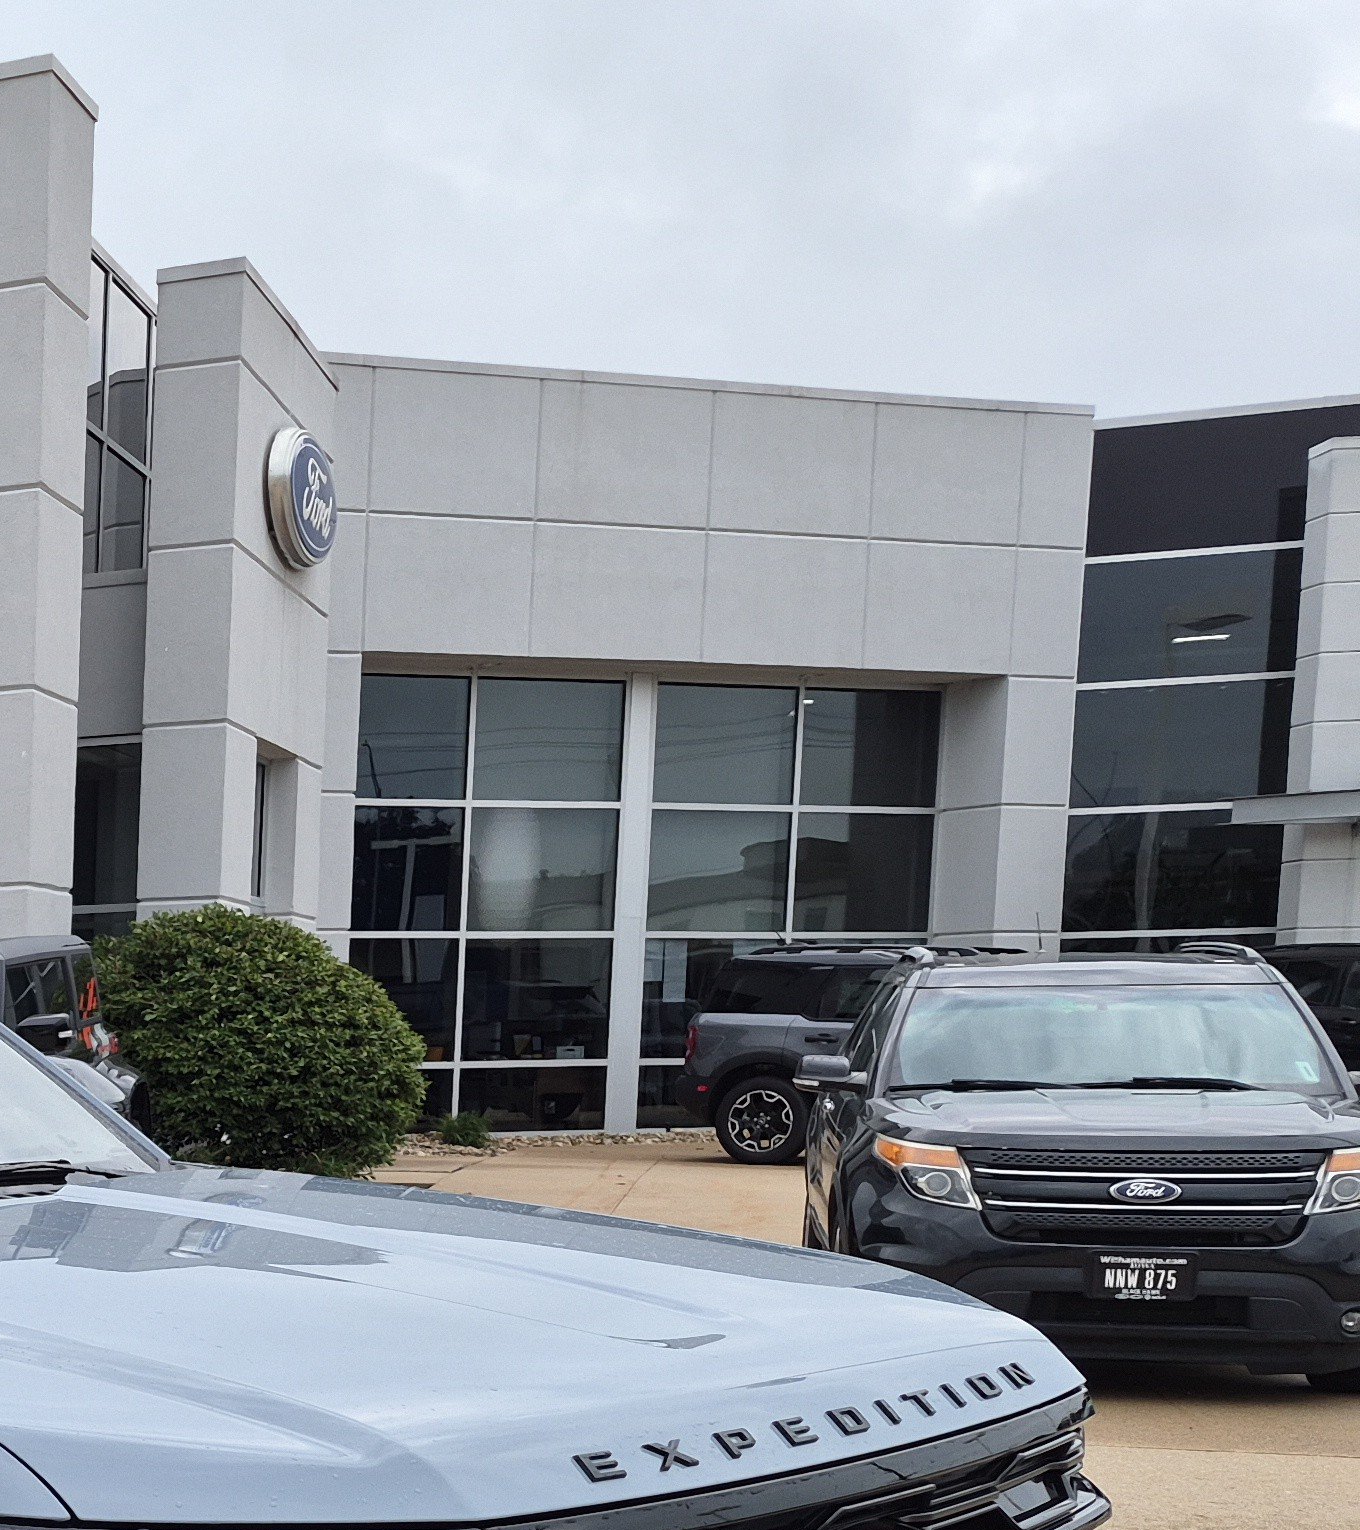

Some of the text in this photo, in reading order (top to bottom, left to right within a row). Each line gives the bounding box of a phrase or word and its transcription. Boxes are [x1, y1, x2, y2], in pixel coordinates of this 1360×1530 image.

[302, 457, 333, 540] Ford
[1126, 1183, 1166, 1197] Ford
[1105, 1268, 1177, 1290] NNW 875
[571, 1361, 1036, 1483] EXPEDITION
